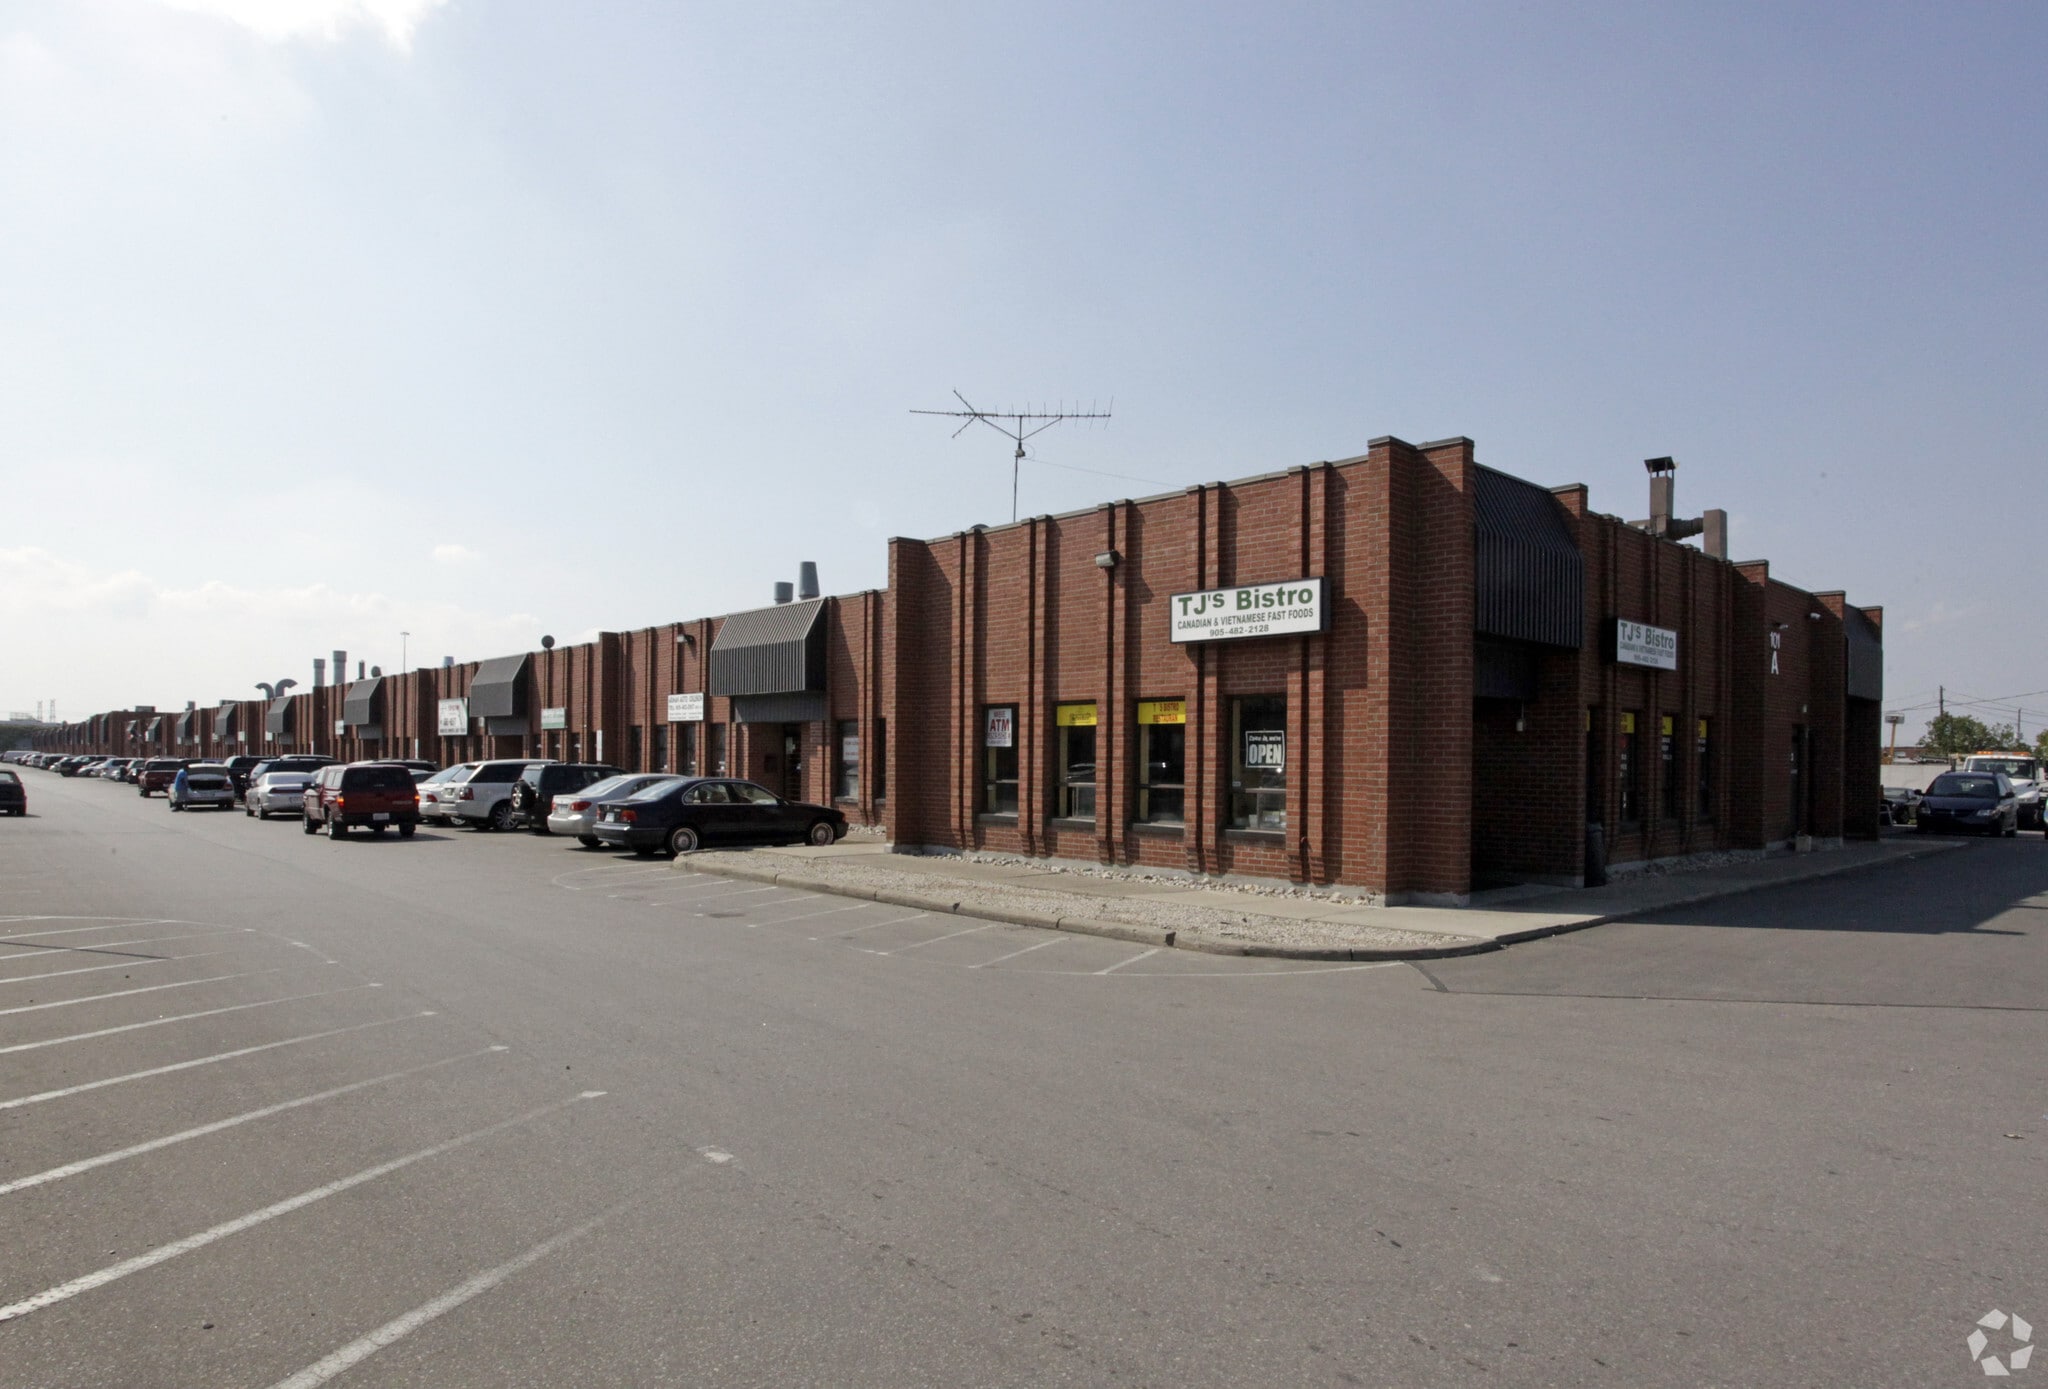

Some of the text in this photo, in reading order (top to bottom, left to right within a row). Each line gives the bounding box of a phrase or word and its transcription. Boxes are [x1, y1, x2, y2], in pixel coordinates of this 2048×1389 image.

[1236, 586, 1313, 610] Bistro
[1177, 608, 1314, 630] CANADIAN & VIETNAMESE FAST FOODS
[1645, 627, 1674, 649] Bistro
[1770, 631, 1780, 649] 101
[1771, 650, 1779, 674] A
[990, 718, 1009, 732] ATM
[1248, 744, 1282, 764] OPEN
